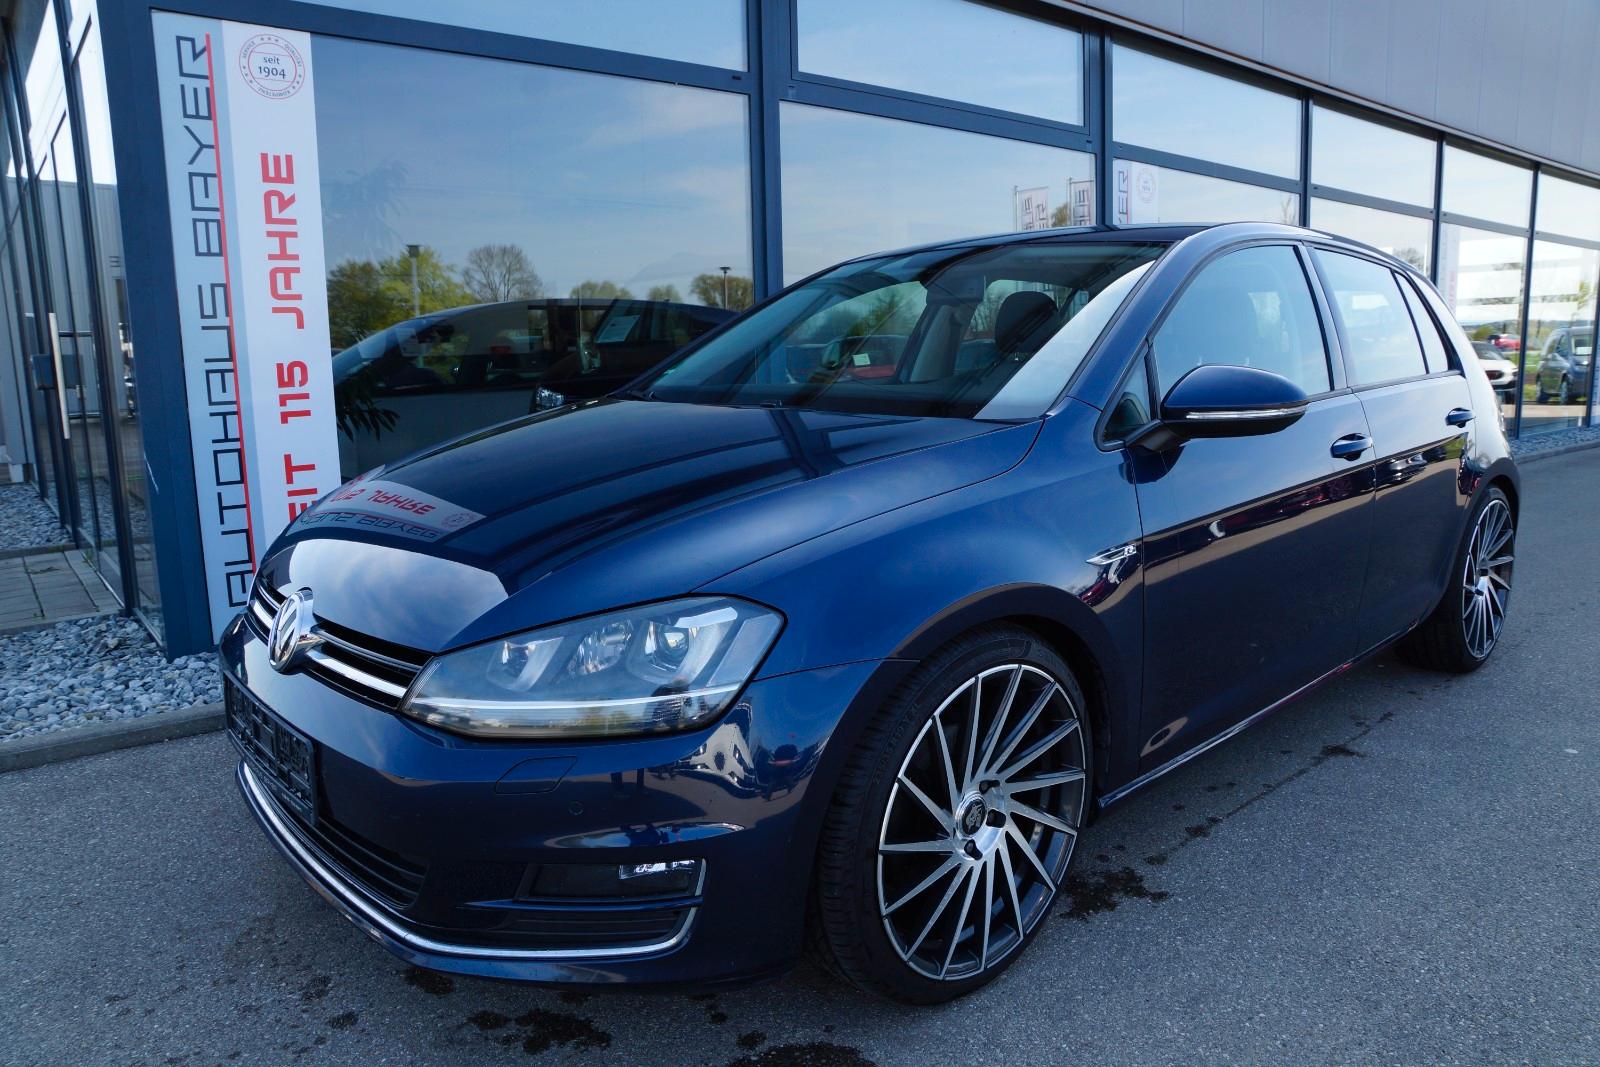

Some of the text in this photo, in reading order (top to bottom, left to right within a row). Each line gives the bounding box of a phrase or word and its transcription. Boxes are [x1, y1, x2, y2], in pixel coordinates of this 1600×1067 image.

[258, 66, 286, 80] 1904
[263, 56, 280, 65] seit
[260, 152, 304, 330] JAHRE
[176, 35, 254, 608] AUTOHAUS BAYER
[276, 360, 312, 424] 115
